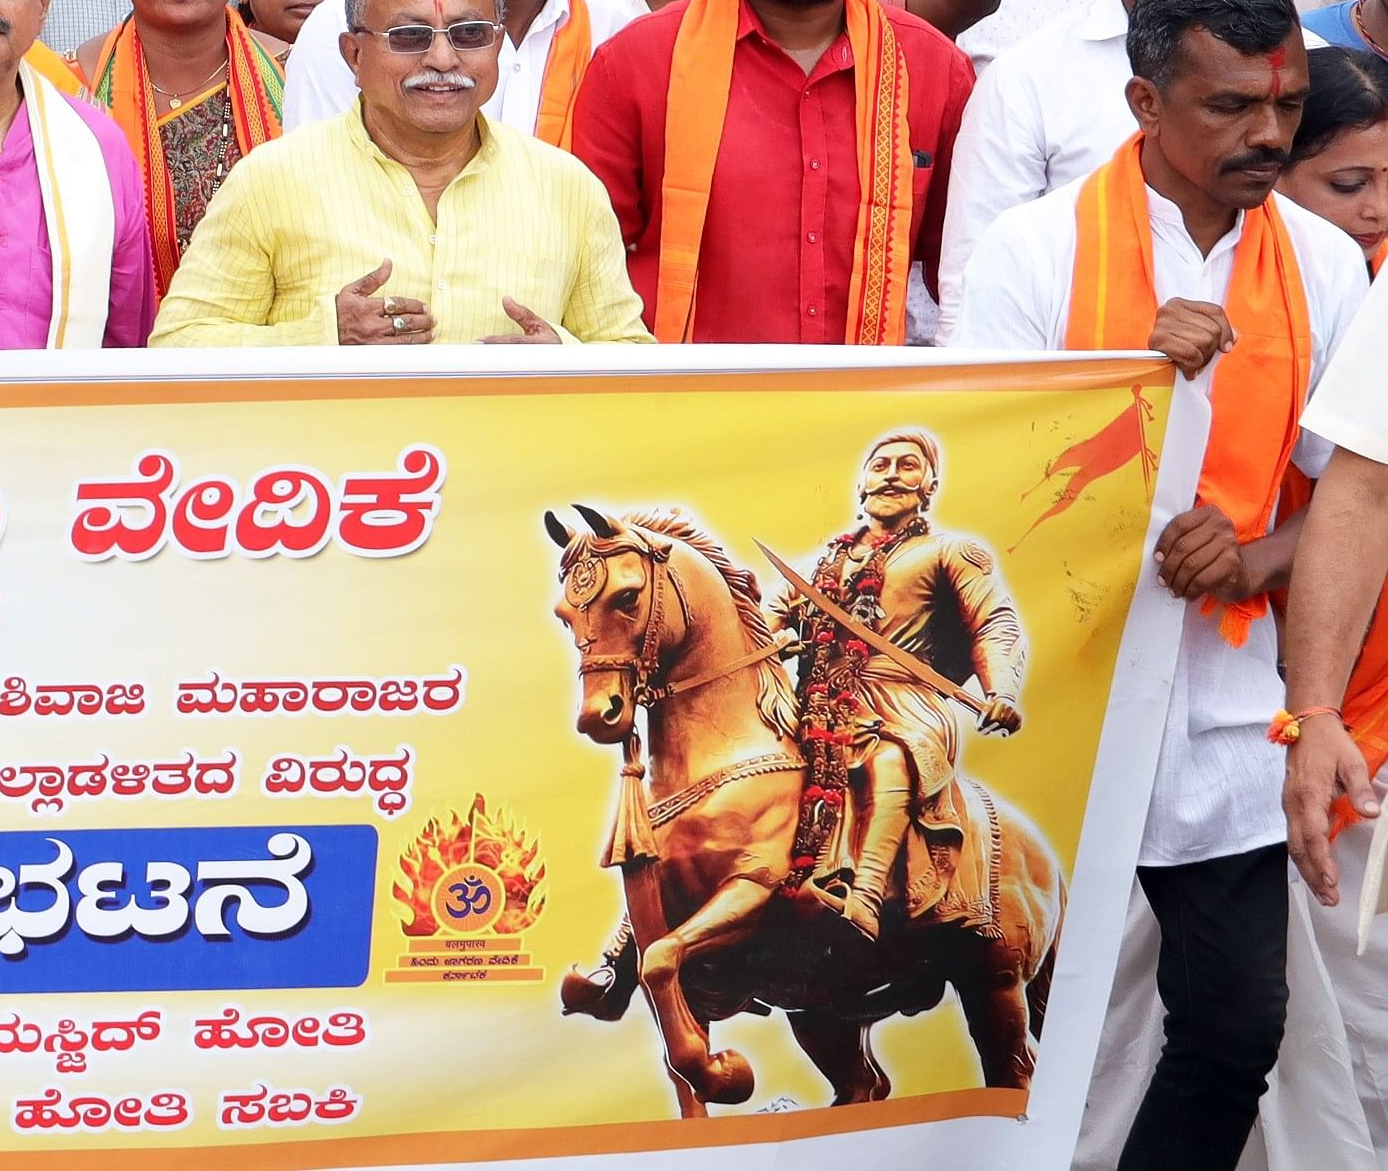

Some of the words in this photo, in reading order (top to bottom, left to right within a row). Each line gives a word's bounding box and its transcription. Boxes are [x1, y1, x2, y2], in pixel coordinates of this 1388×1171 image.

[72, 450, 438, 554] ವೇದಿಕೆ
[178, 674, 460, 713] ಮಹಾರಾಜರ
[267, 754, 407, 812] ವಿರುದ್ಧ
[195, 1007, 365, 1048] ಹೋತಿ
[16, 1088, 187, 1128] ಹೋತಿ
[223, 1087, 354, 1123] ಸಬಕಿ
